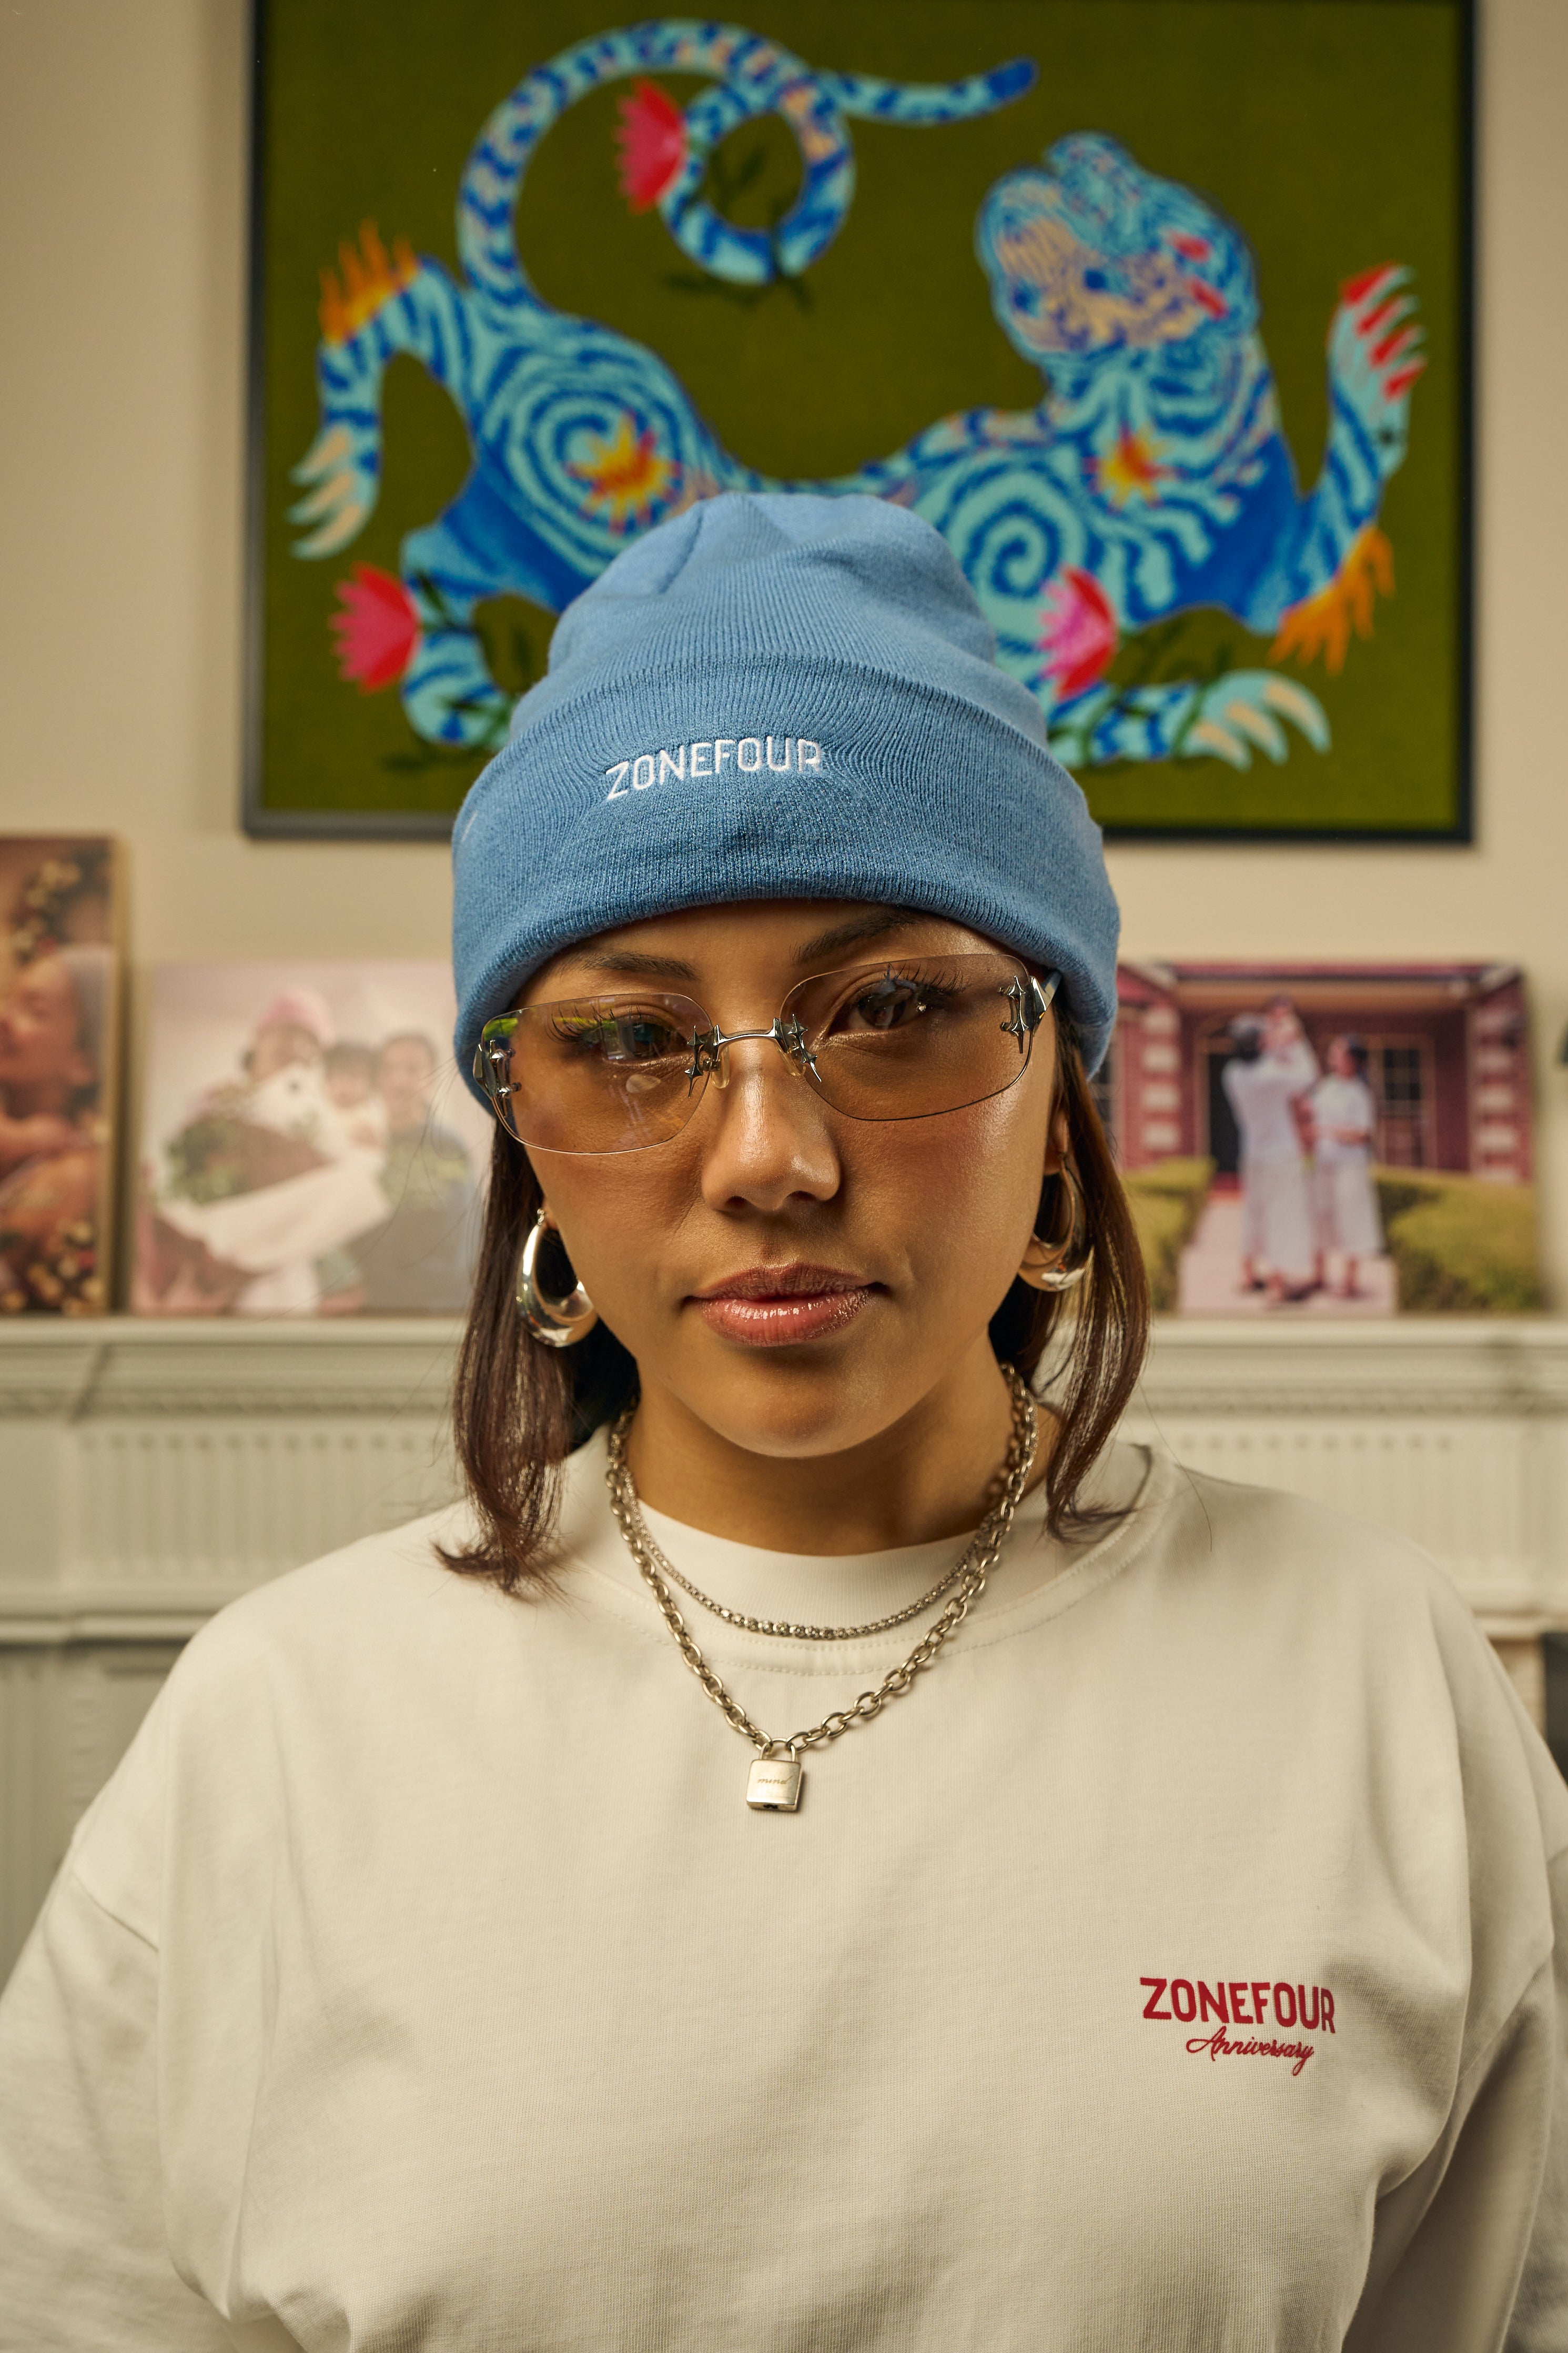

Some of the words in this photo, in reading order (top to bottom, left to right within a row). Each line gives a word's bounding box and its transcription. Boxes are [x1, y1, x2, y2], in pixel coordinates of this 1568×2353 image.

[605, 736, 822, 800] ZONEFOUR
[1140, 1977, 1336, 2033] ZONEFOUR
[1186, 2026, 1314, 2076] Anniversary
